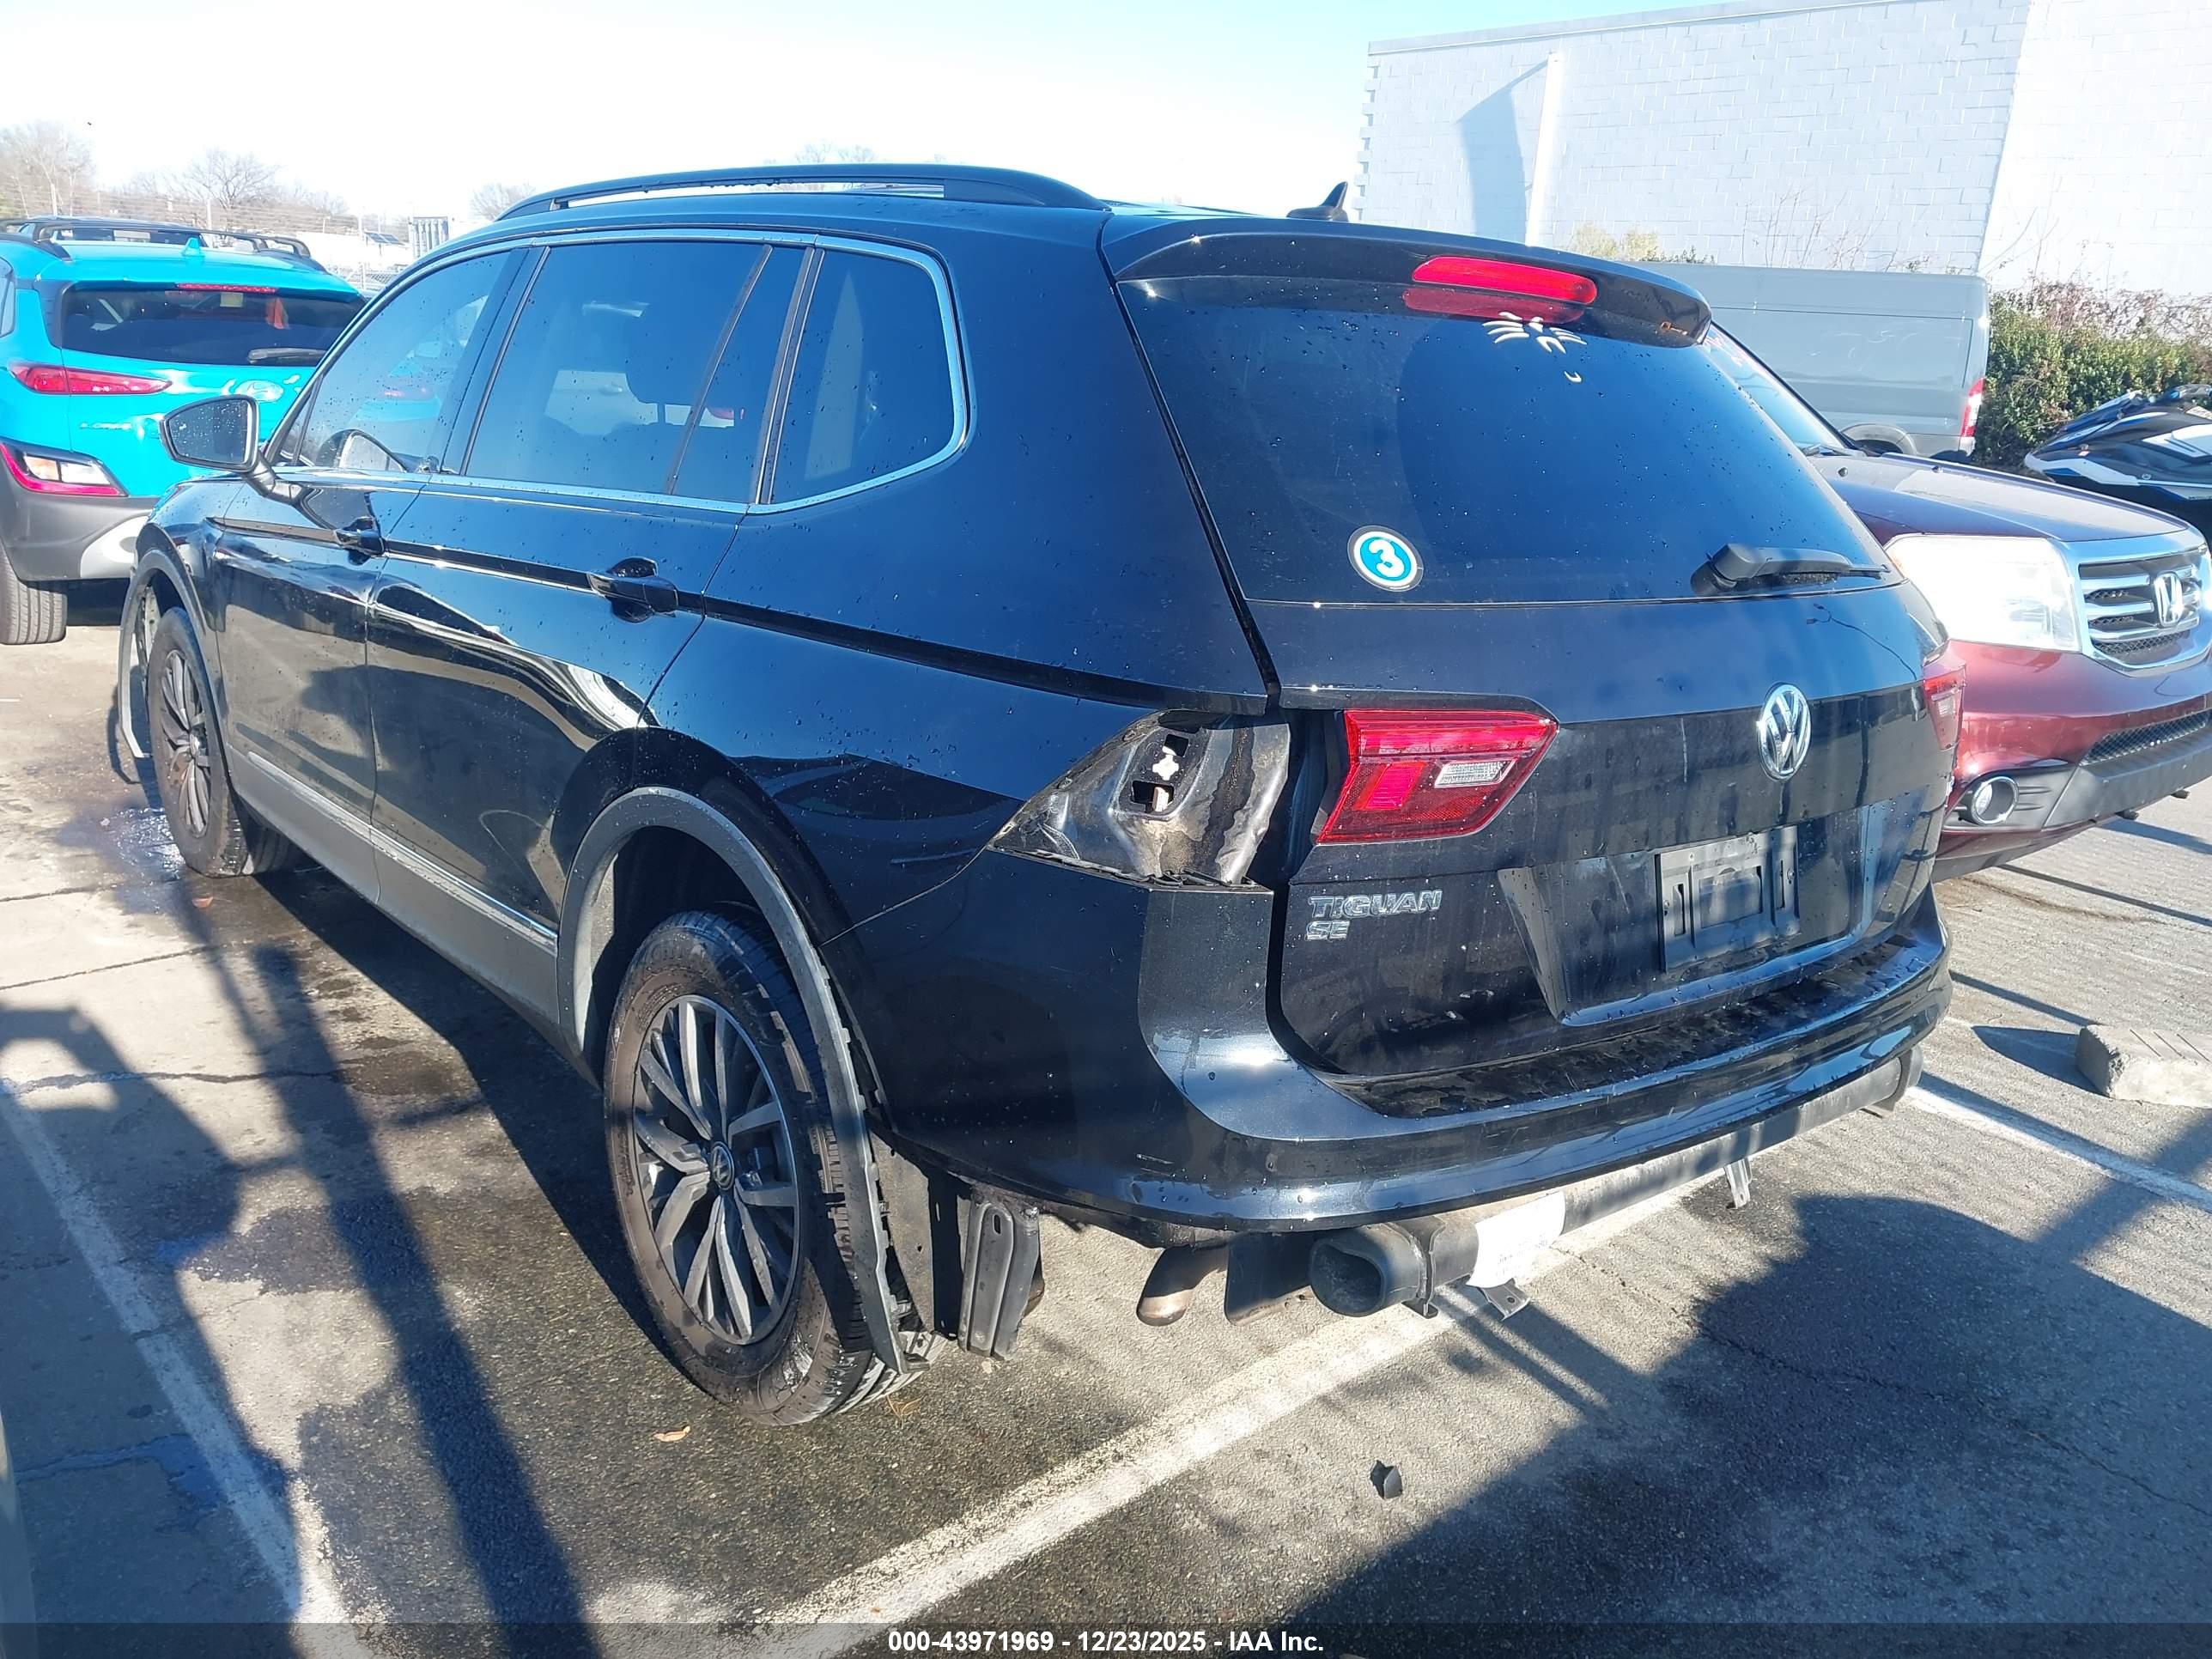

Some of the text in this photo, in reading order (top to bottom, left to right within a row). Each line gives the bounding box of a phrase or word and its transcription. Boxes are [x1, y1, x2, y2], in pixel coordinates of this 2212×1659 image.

[1368, 539, 1405, 578] 3
[1308, 889, 1443, 918] TIGUAN
[1304, 920, 1350, 942] SE
